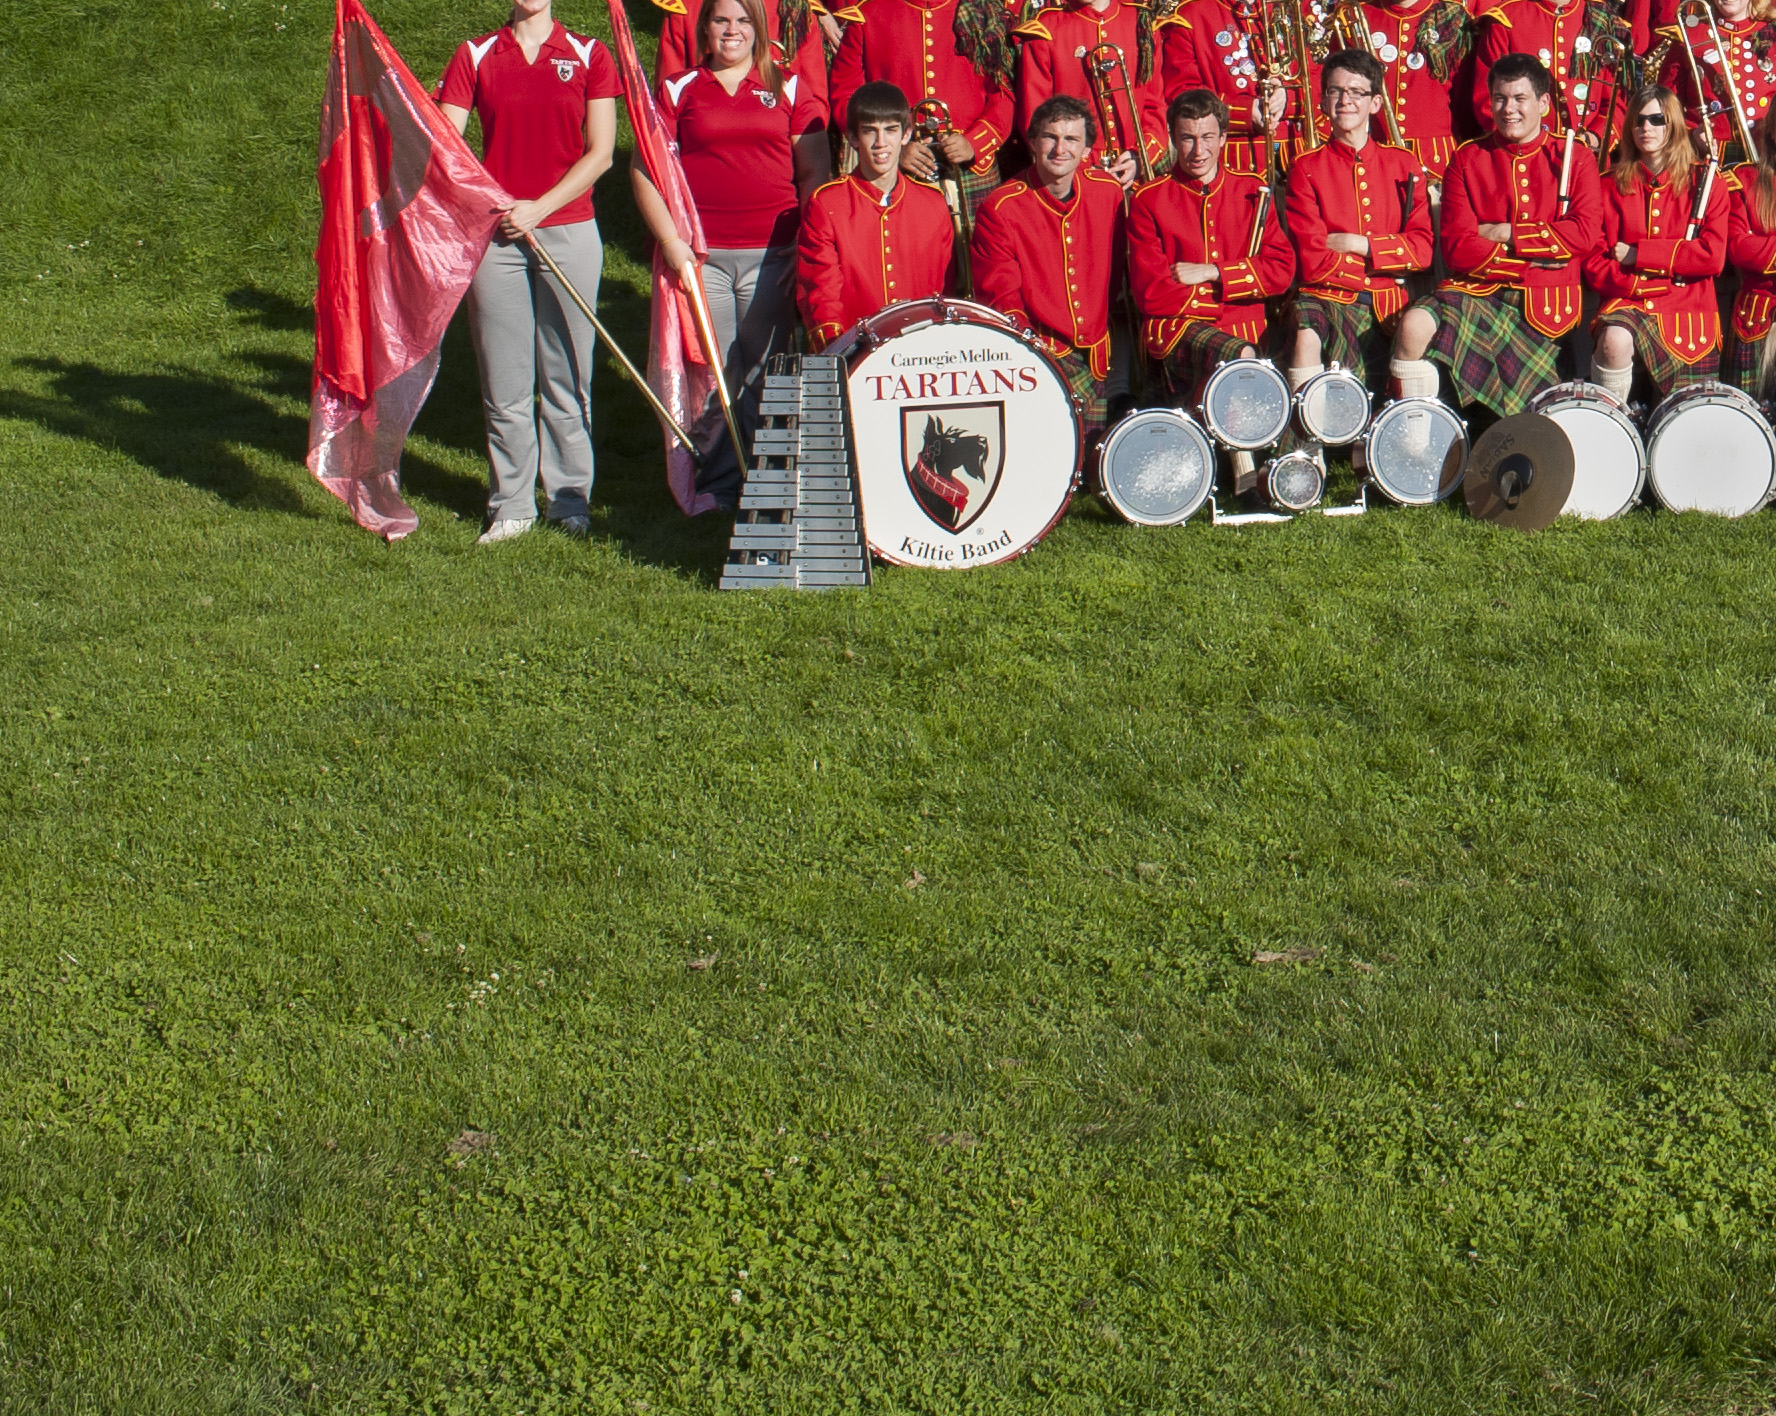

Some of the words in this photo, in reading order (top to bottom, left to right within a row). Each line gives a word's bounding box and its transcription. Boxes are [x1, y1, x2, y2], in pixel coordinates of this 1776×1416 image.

[891, 351, 957, 368] Carnegie
[959, 348, 1011, 364] Mellon
[865, 366, 1038, 401] TARTANS
[899, 536, 954, 561] Kiltie
[961, 529, 1013, 560] Band
